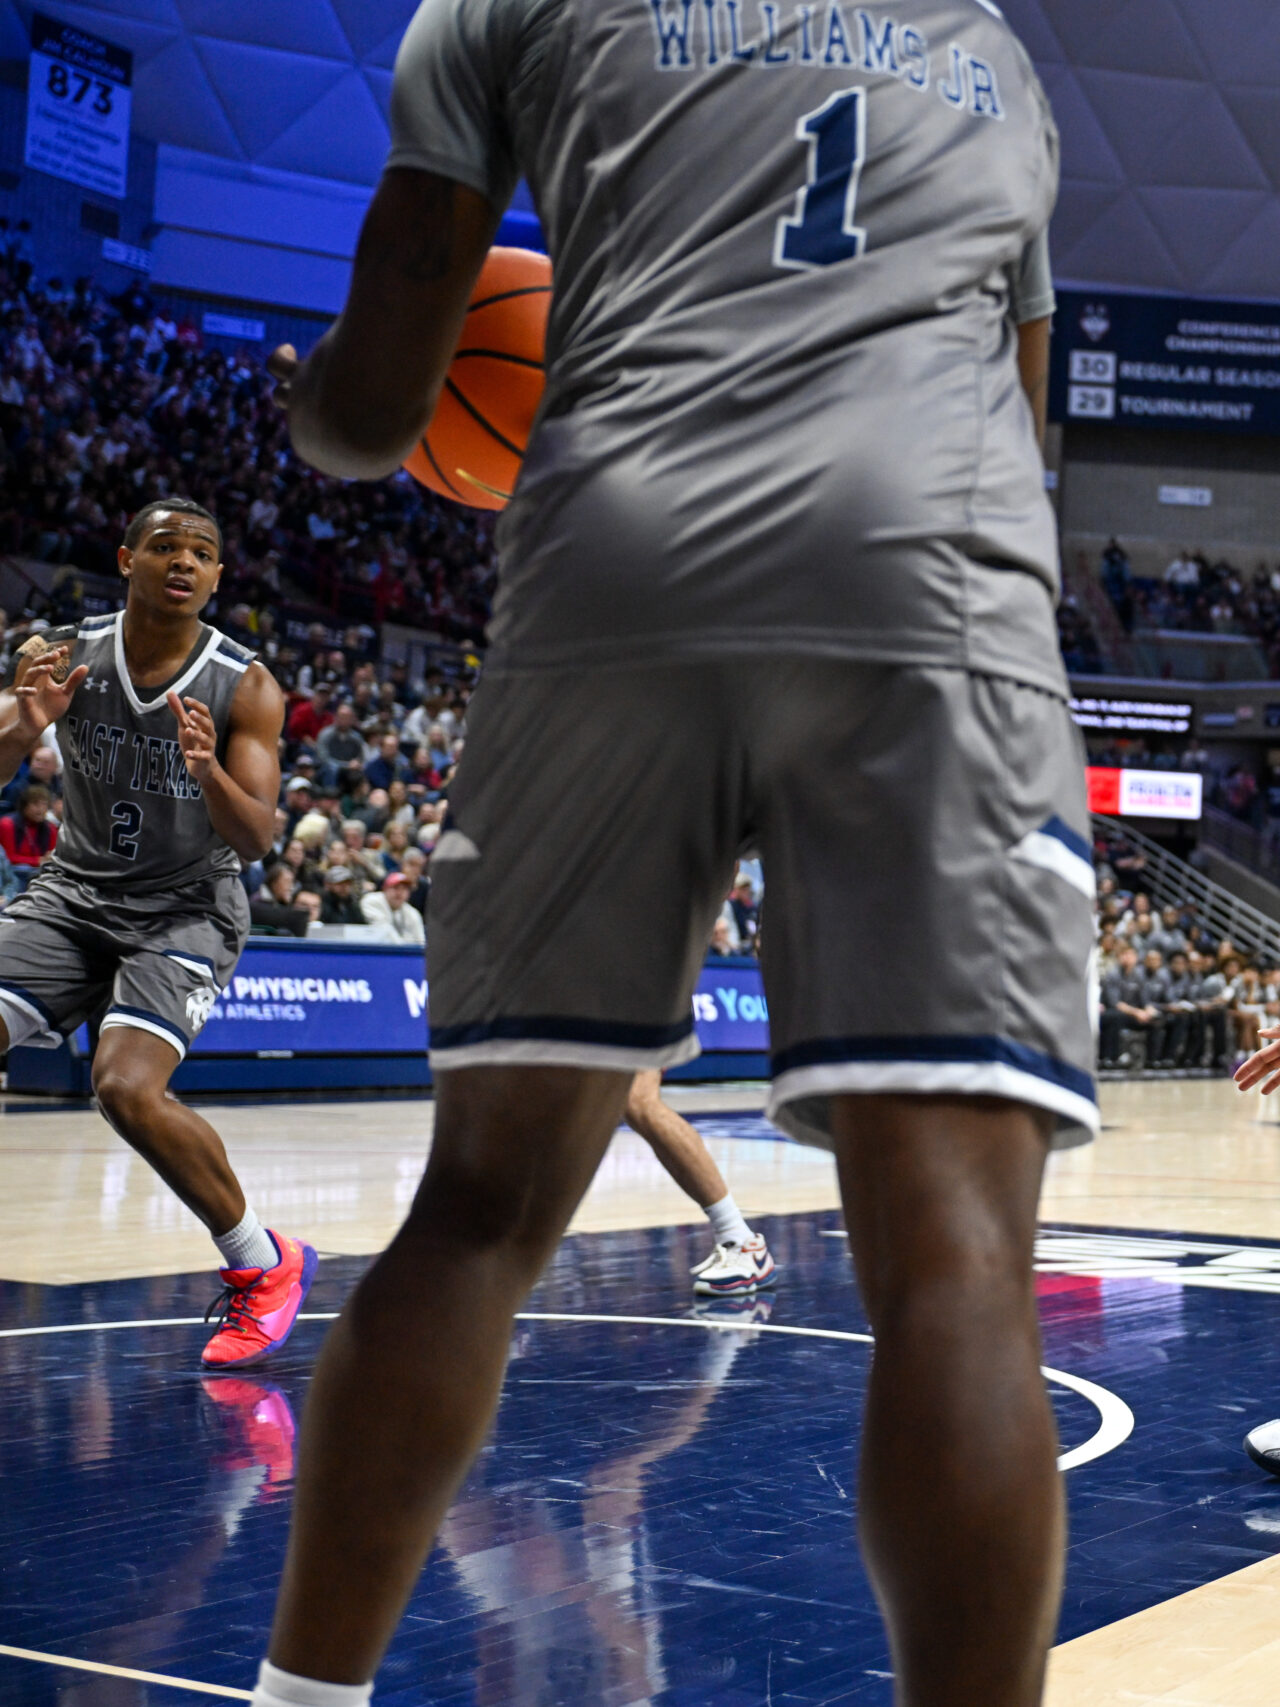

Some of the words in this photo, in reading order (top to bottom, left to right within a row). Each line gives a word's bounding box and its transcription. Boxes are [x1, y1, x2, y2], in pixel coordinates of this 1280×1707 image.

[649, 0, 930, 92] WILLIAMS
[938, 42, 1005, 121] JR
[48, 63, 114, 115] 873
[773, 85, 867, 271] 1
[1119, 361, 1211, 384] REGULAR
[1120, 395, 1255, 420] TOURNAMENT
[67, 715, 127, 786] EAST
[108, 800, 144, 861] 2
[226, 1003, 307, 1022] ATHLETICS
[233, 976, 373, 1003] PHYSICIANS
